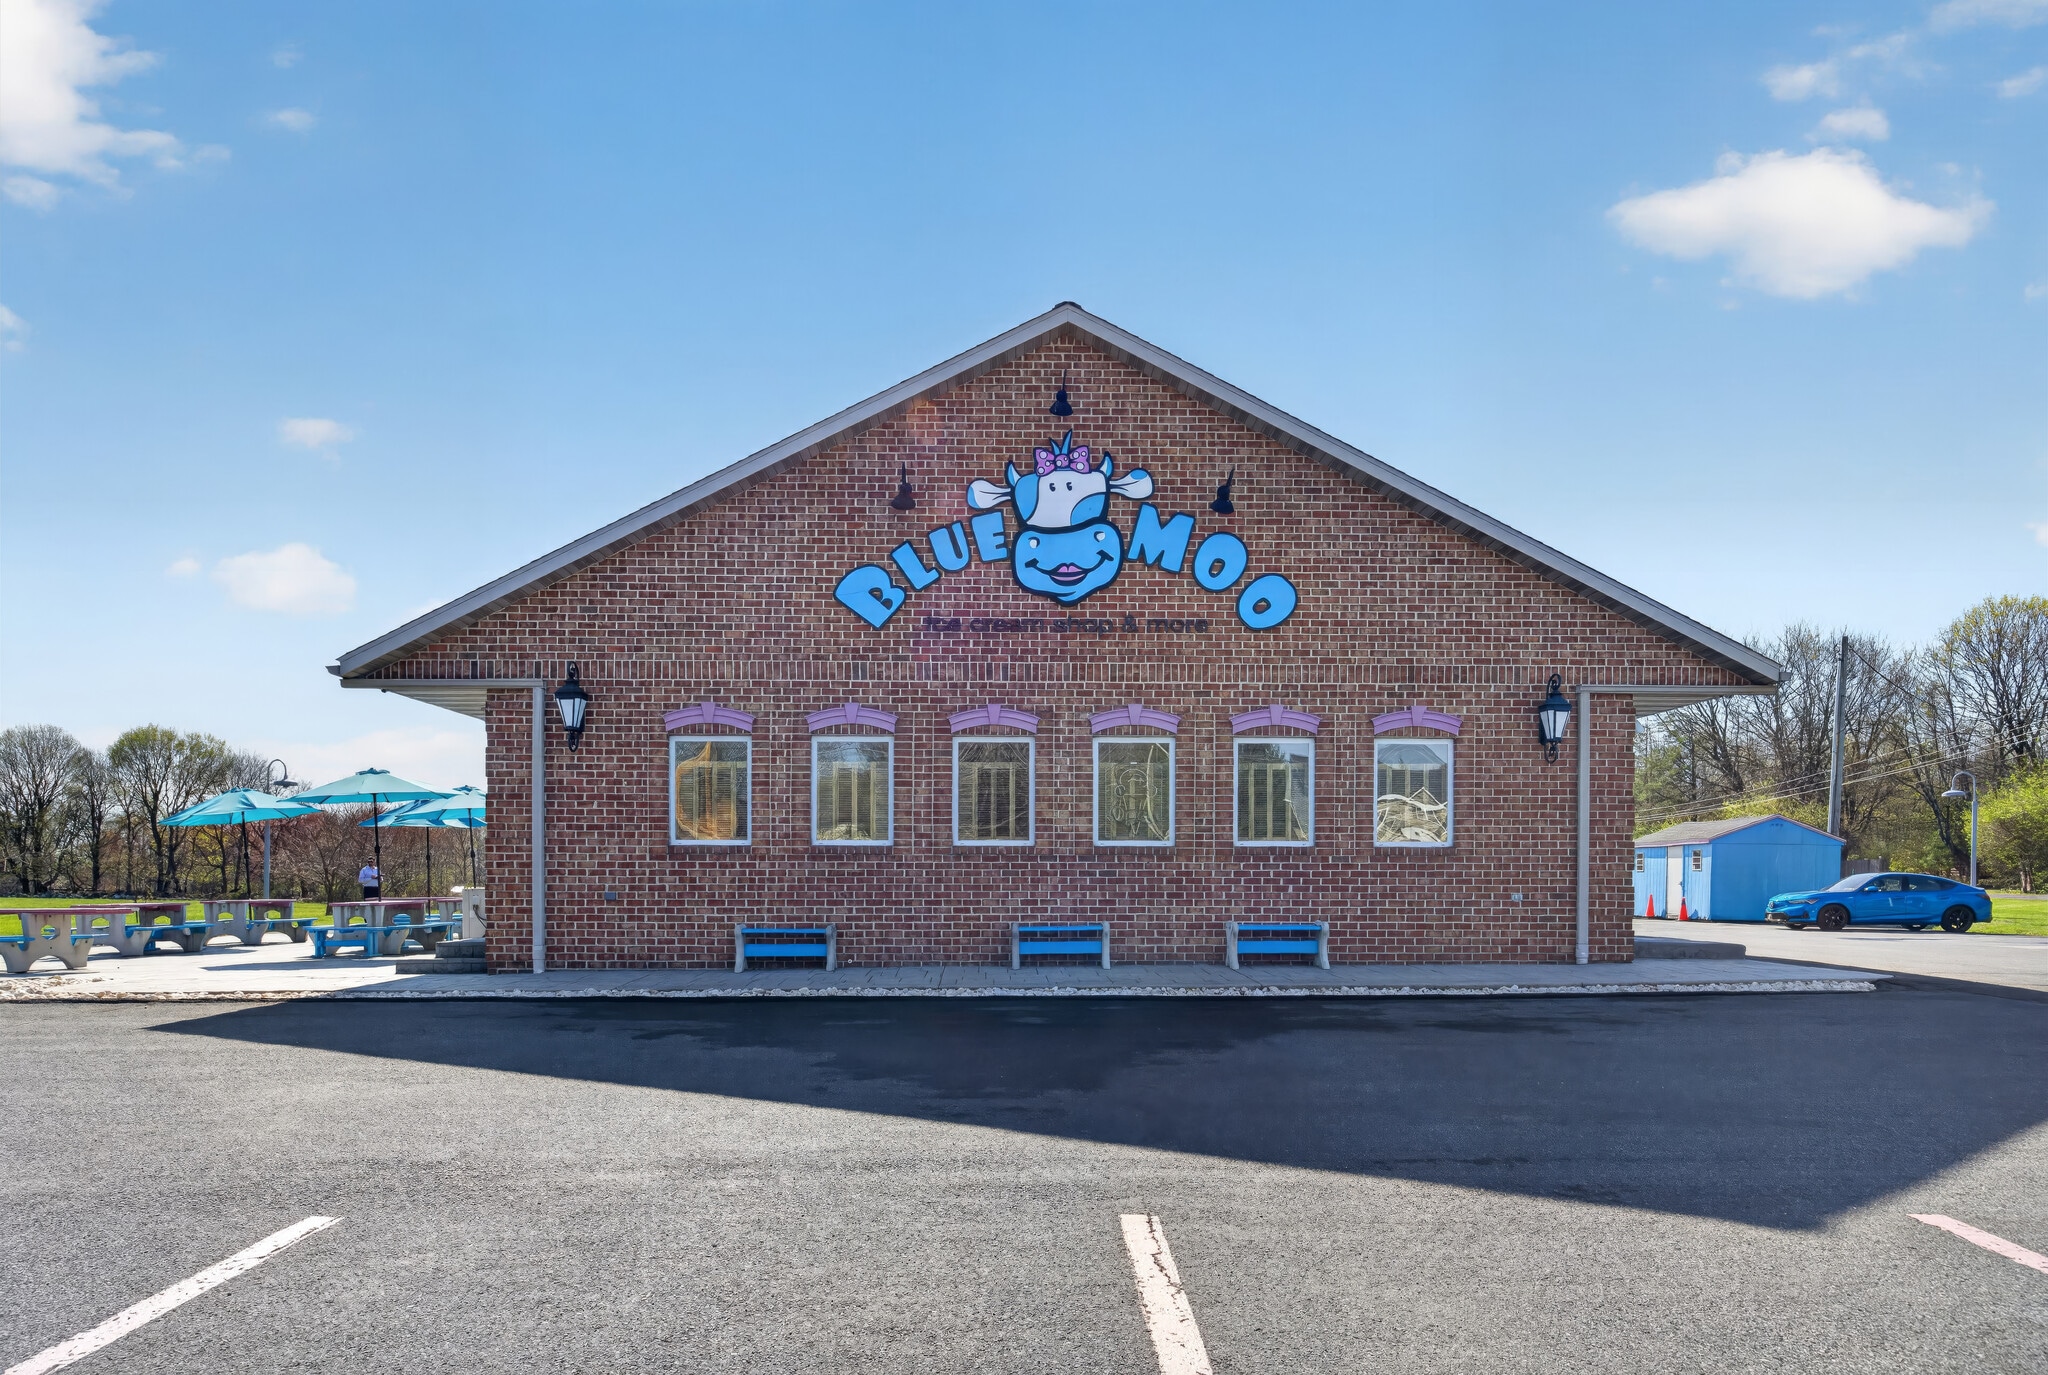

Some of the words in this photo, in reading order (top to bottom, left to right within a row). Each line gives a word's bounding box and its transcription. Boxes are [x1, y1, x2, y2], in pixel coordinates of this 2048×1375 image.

[833, 511, 1009, 629] BLUE
[1127, 502, 1298, 630] MOO
[969, 617, 1044, 632] cream
[1053, 615, 1113, 635] shop
[1122, 614, 1138, 632] &
[1147, 617, 1208, 632] more
